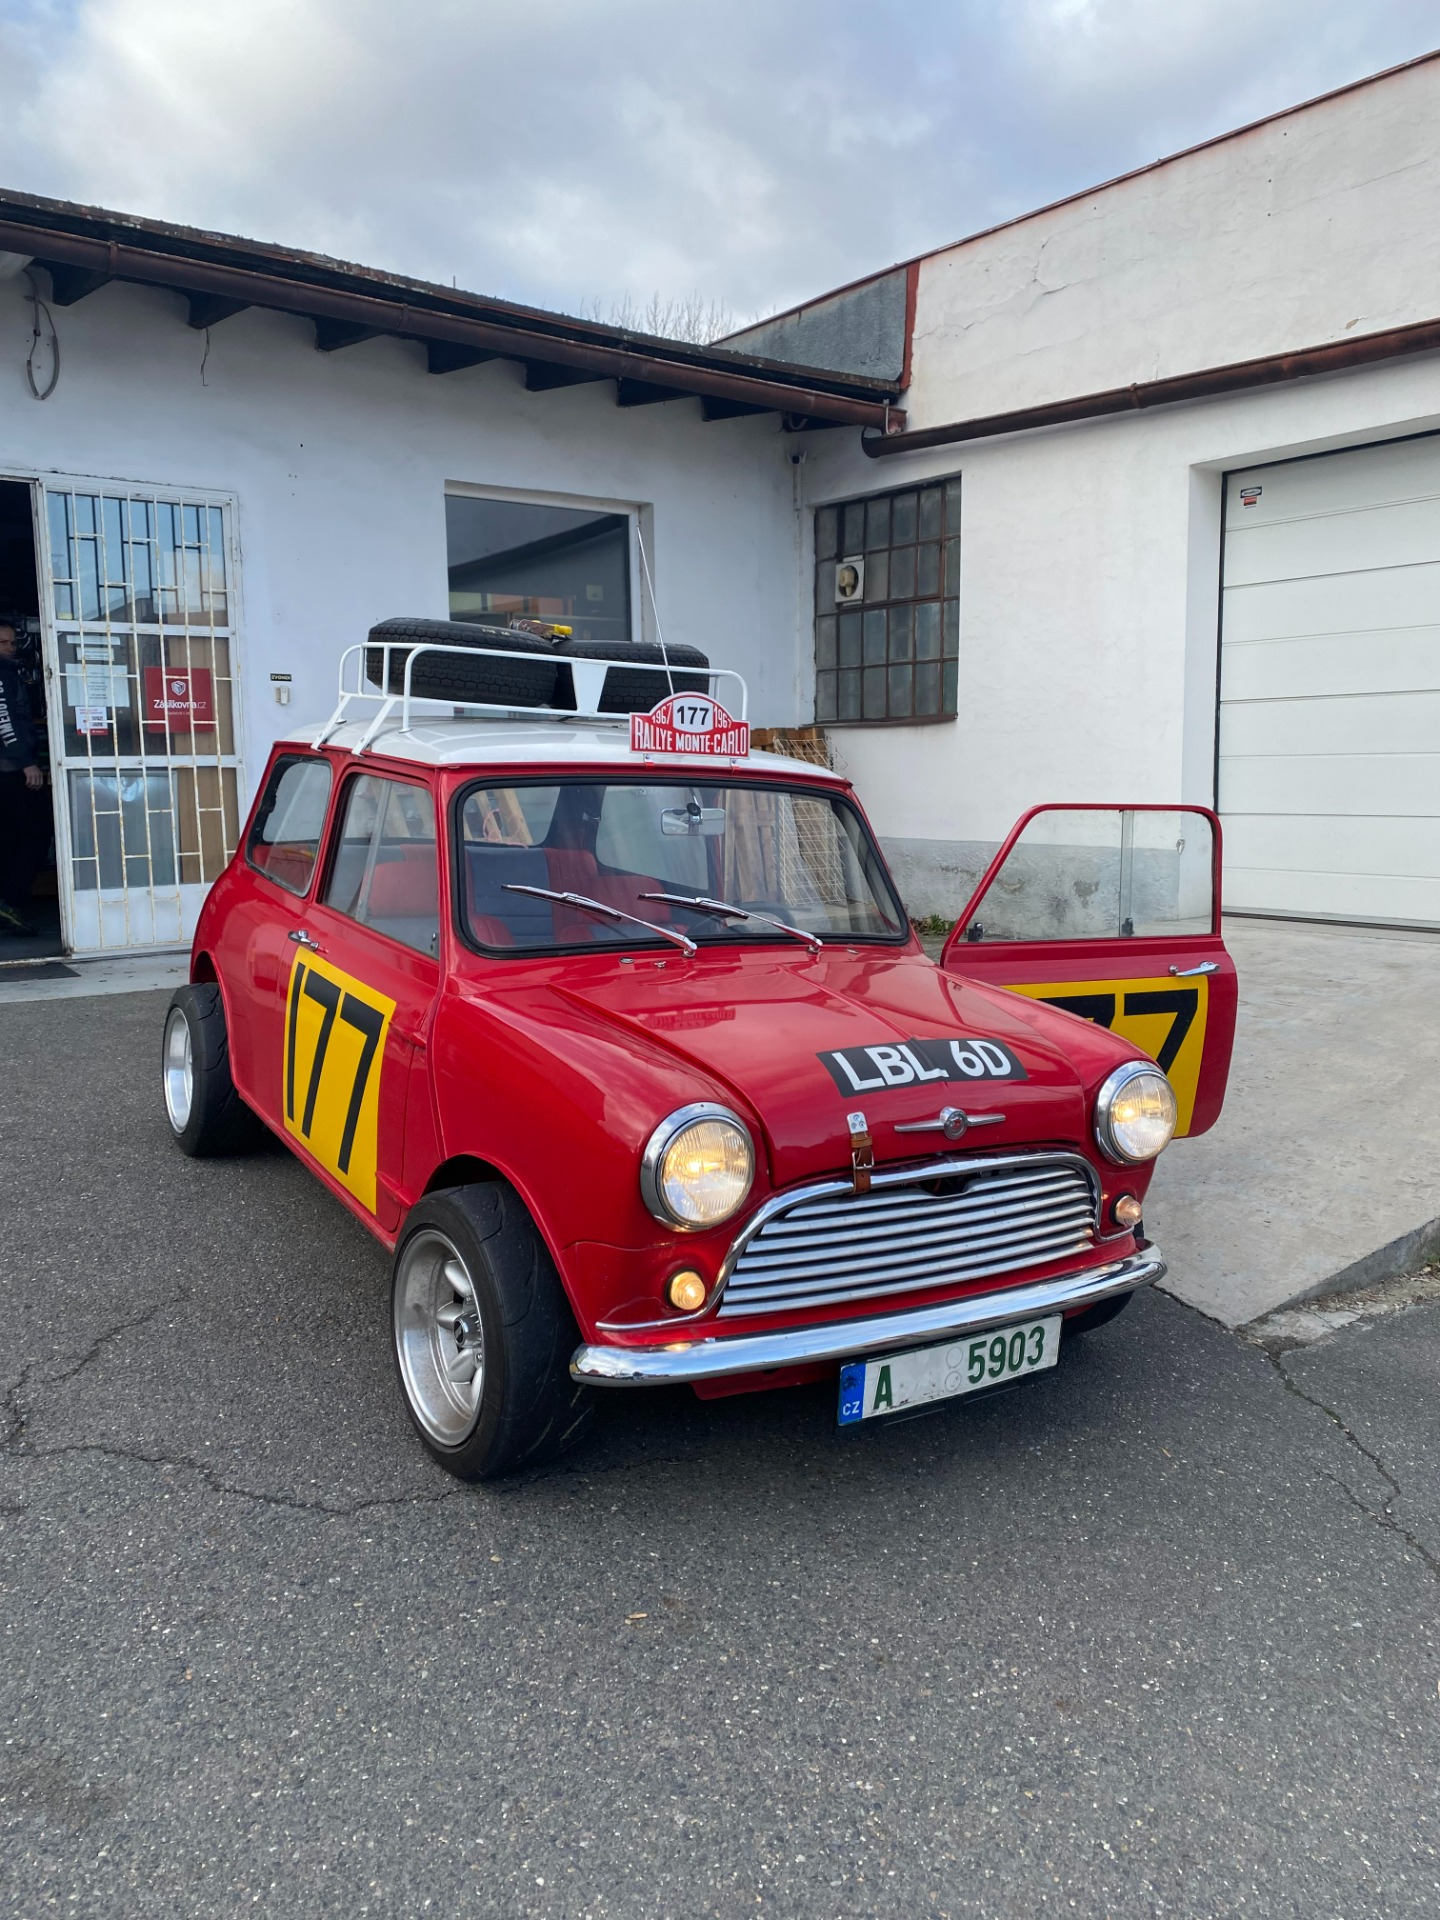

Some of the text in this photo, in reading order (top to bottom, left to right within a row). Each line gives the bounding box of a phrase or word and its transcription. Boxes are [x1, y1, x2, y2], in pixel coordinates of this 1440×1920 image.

[153, 699, 206, 709] Záilkovna.cz
[651, 701, 673, 725] 1967
[677, 705, 710, 726] 177
[713, 705, 733, 729] 1967
[634, 716, 747, 755] RALLYE MONTE-CARLO
[286, 961, 385, 1176] 177
[831, 1040, 1012, 1091] LBL 6D
[842, 1325, 1046, 1416] CZ A 5903
